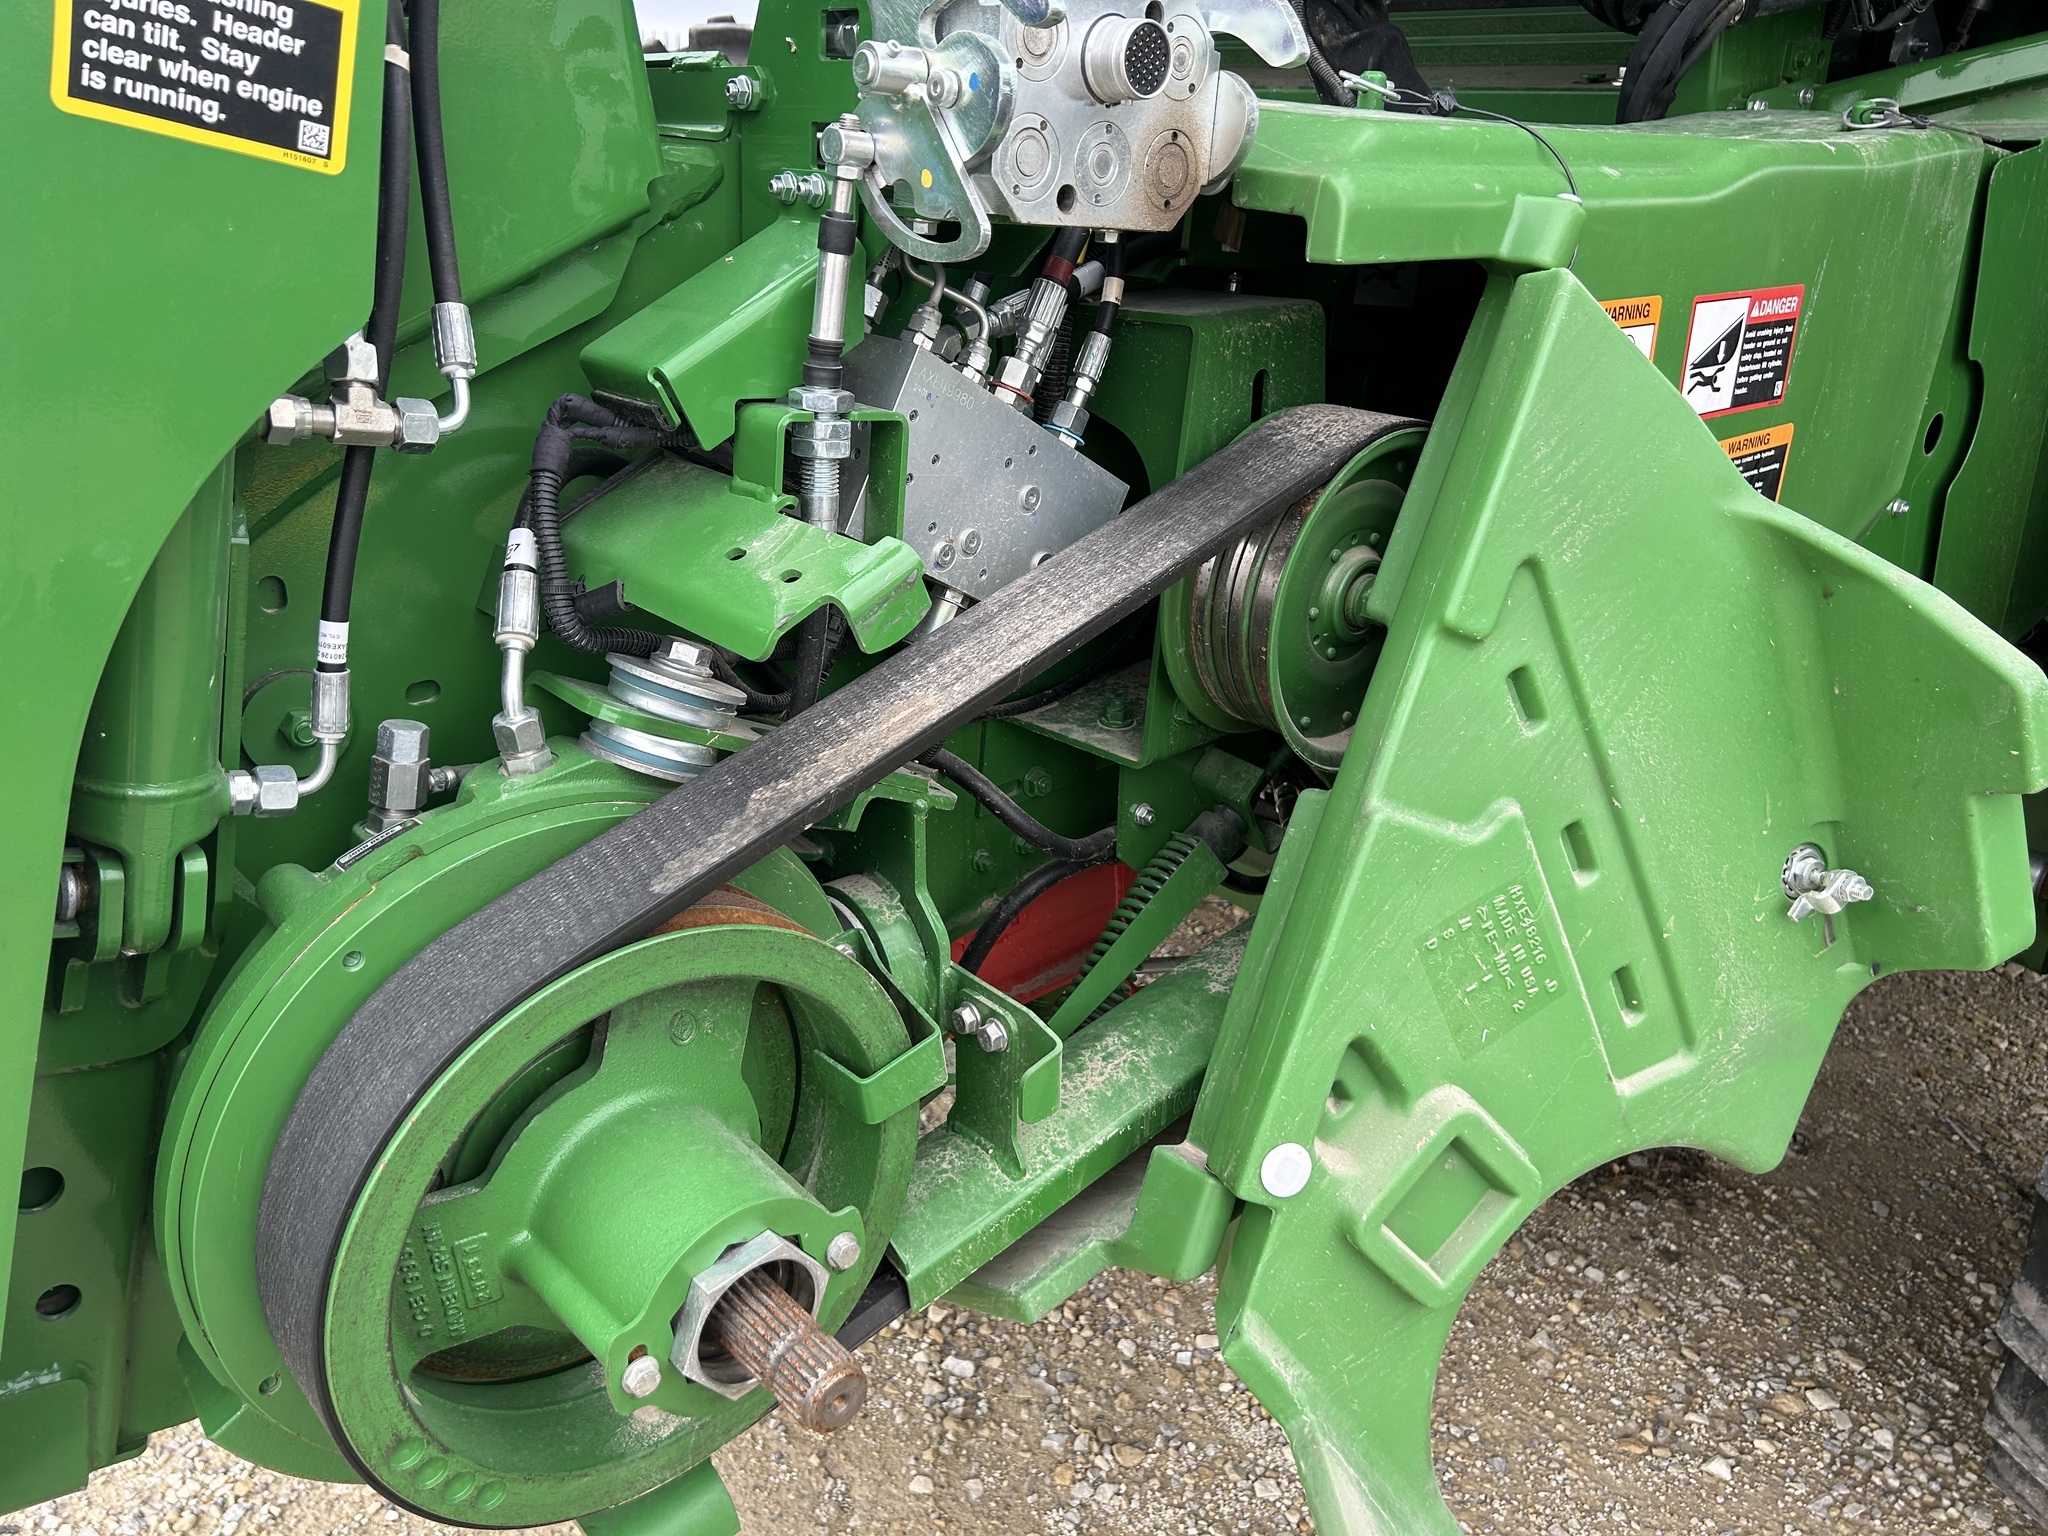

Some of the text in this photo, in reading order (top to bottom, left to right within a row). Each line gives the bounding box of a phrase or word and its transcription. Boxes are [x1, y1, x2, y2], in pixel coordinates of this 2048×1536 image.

[83, 9, 261, 77] can tilt. Stay
[212, 9, 306, 57] Header
[81, 62, 227, 124] is running.
[82, 38, 323, 117] clear when engine
[283, 151, 317, 164] H151607
[1759, 296, 1798, 317] DANGER
[1728, 432, 1771, 455] WARNING
[1492, 893, 1540, 998] MADE IN USA
